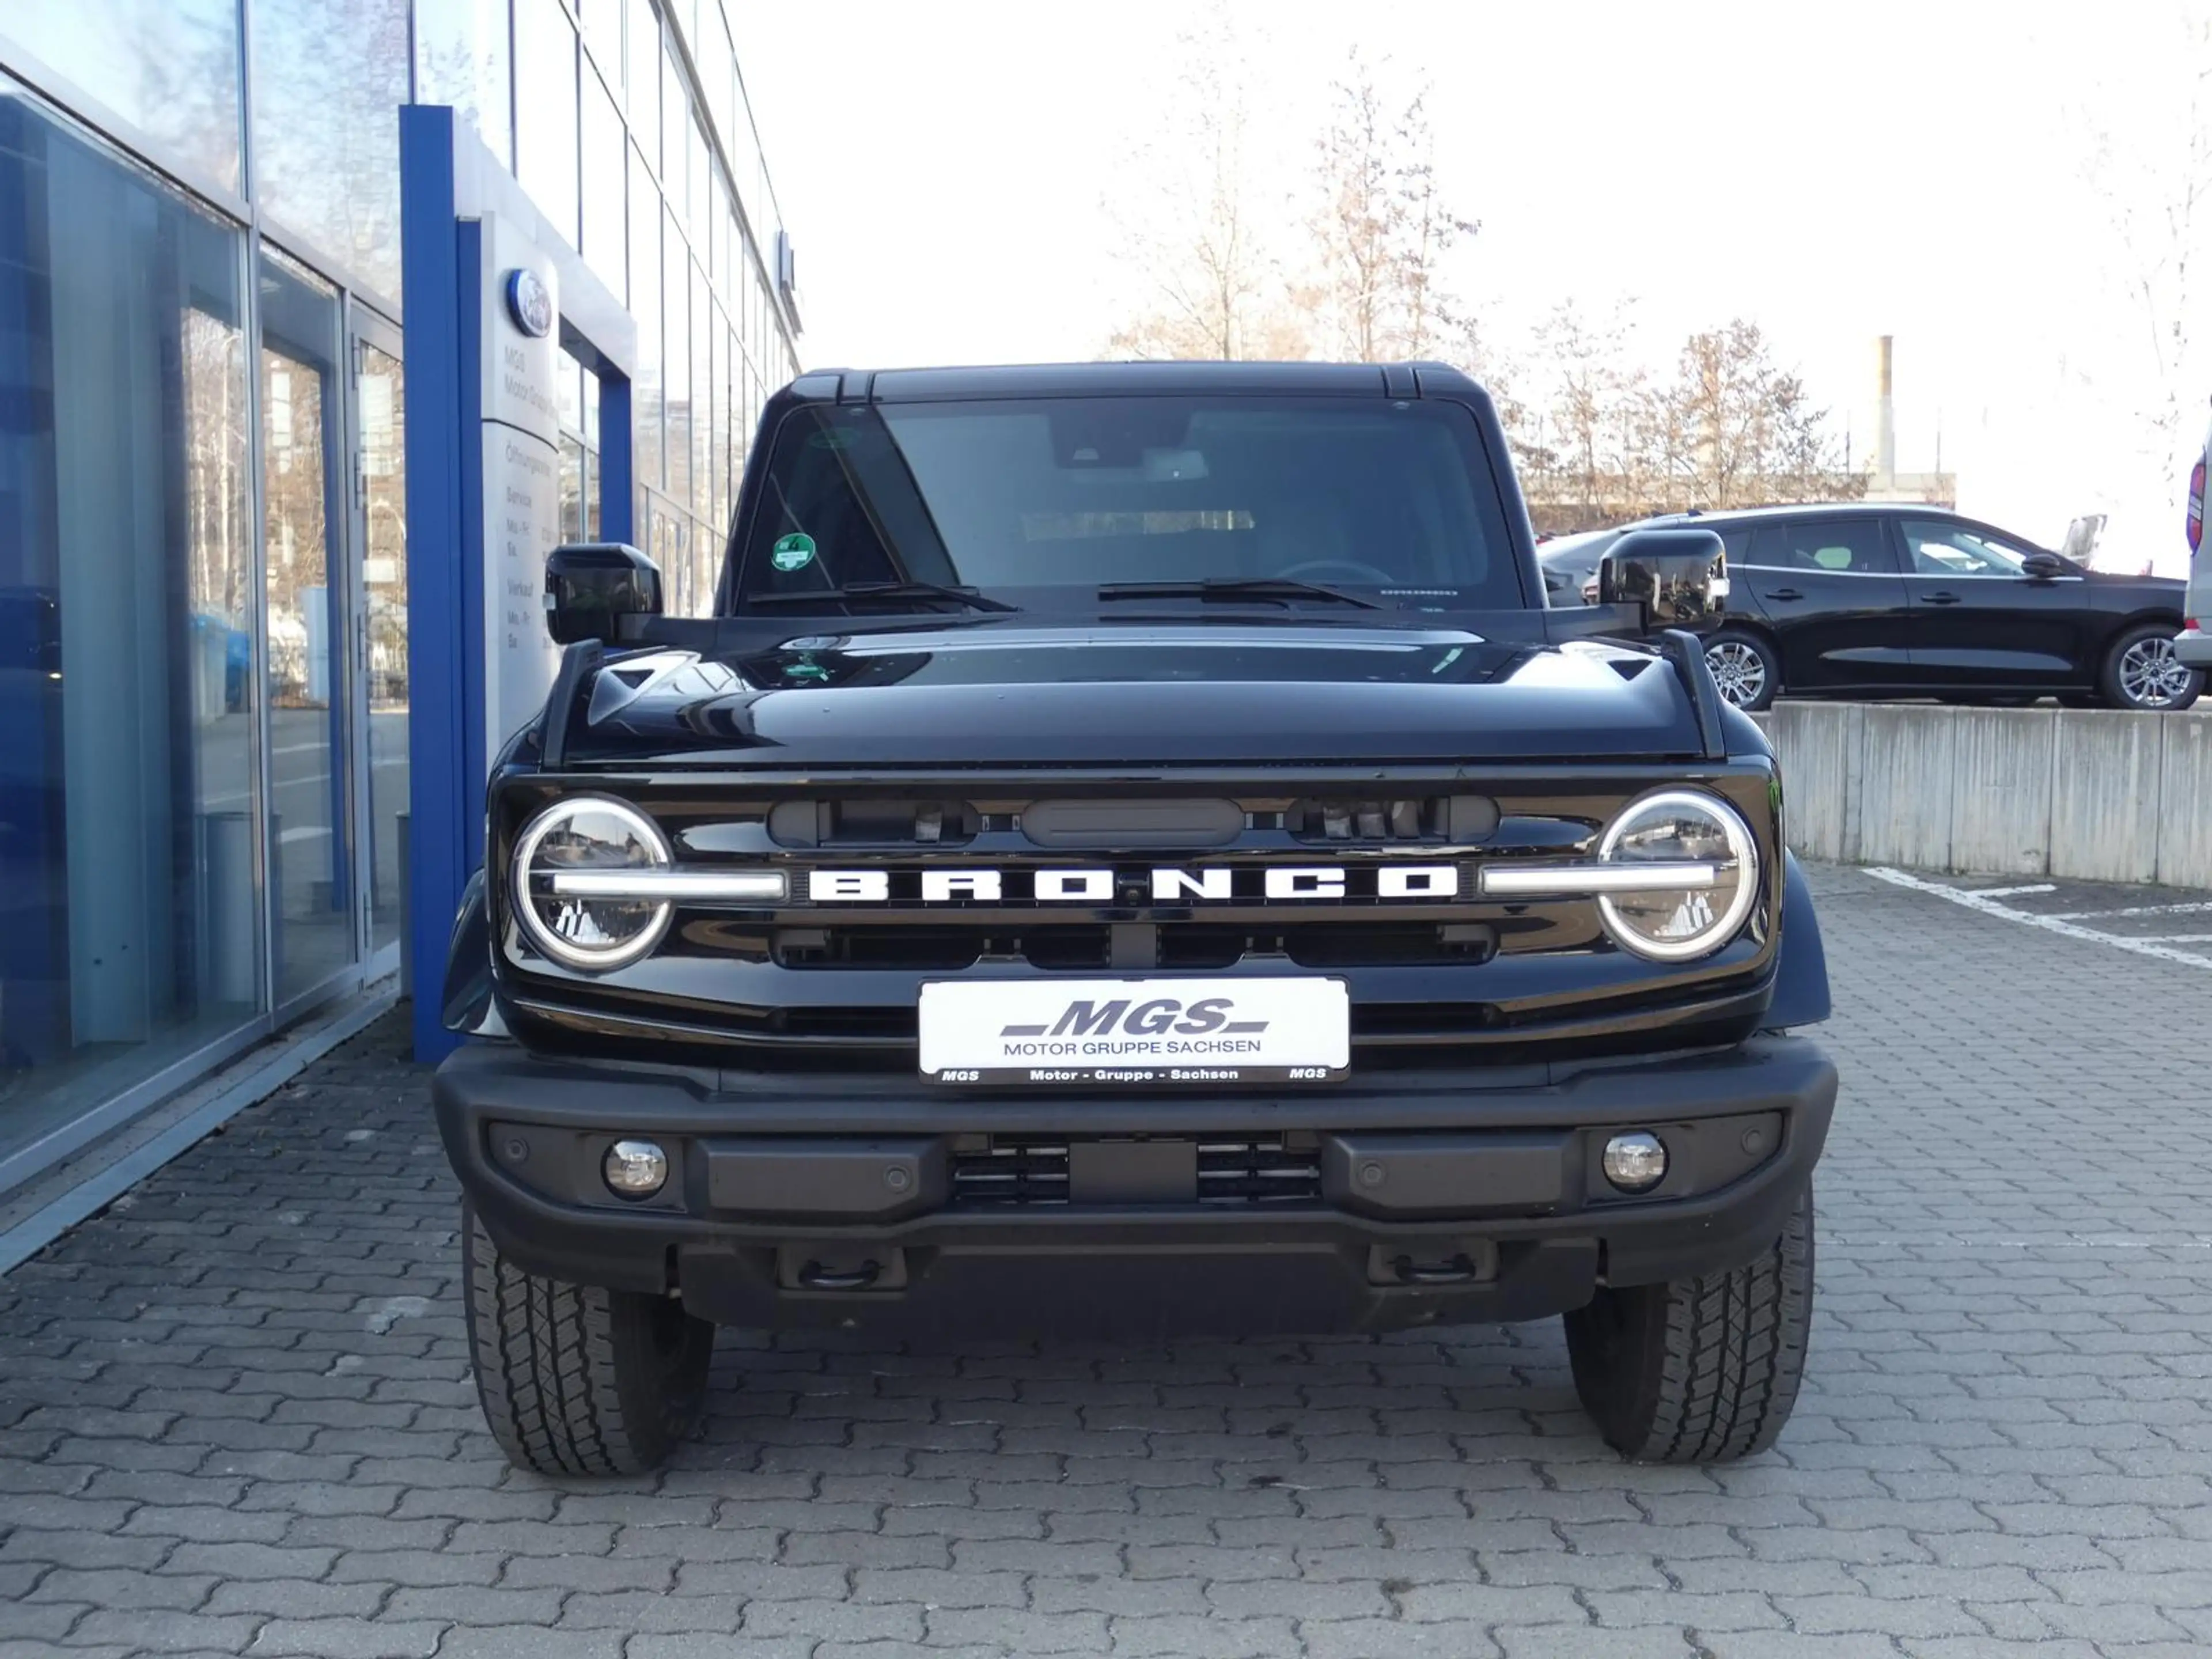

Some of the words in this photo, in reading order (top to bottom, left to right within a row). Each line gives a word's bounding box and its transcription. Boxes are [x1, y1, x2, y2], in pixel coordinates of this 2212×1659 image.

[788, 535, 800, 551] 4
[809, 866, 1459, 902] BRONCO
[1049, 998, 1234, 1036] MGS
[1004, 1043, 1077, 1056] MOTOR
[1082, 1041, 1162, 1055] GRUPPE
[1166, 1040, 1262, 1054] SACHSEN
[941, 1070, 980, 1082] MGS
[1029, 1070, 1079, 1081] Motor
[1094, 1069, 1154, 1081] Gruppe
[1170, 1069, 1239, 1080] Sachsen
[1289, 1068, 1327, 1079] MGS
